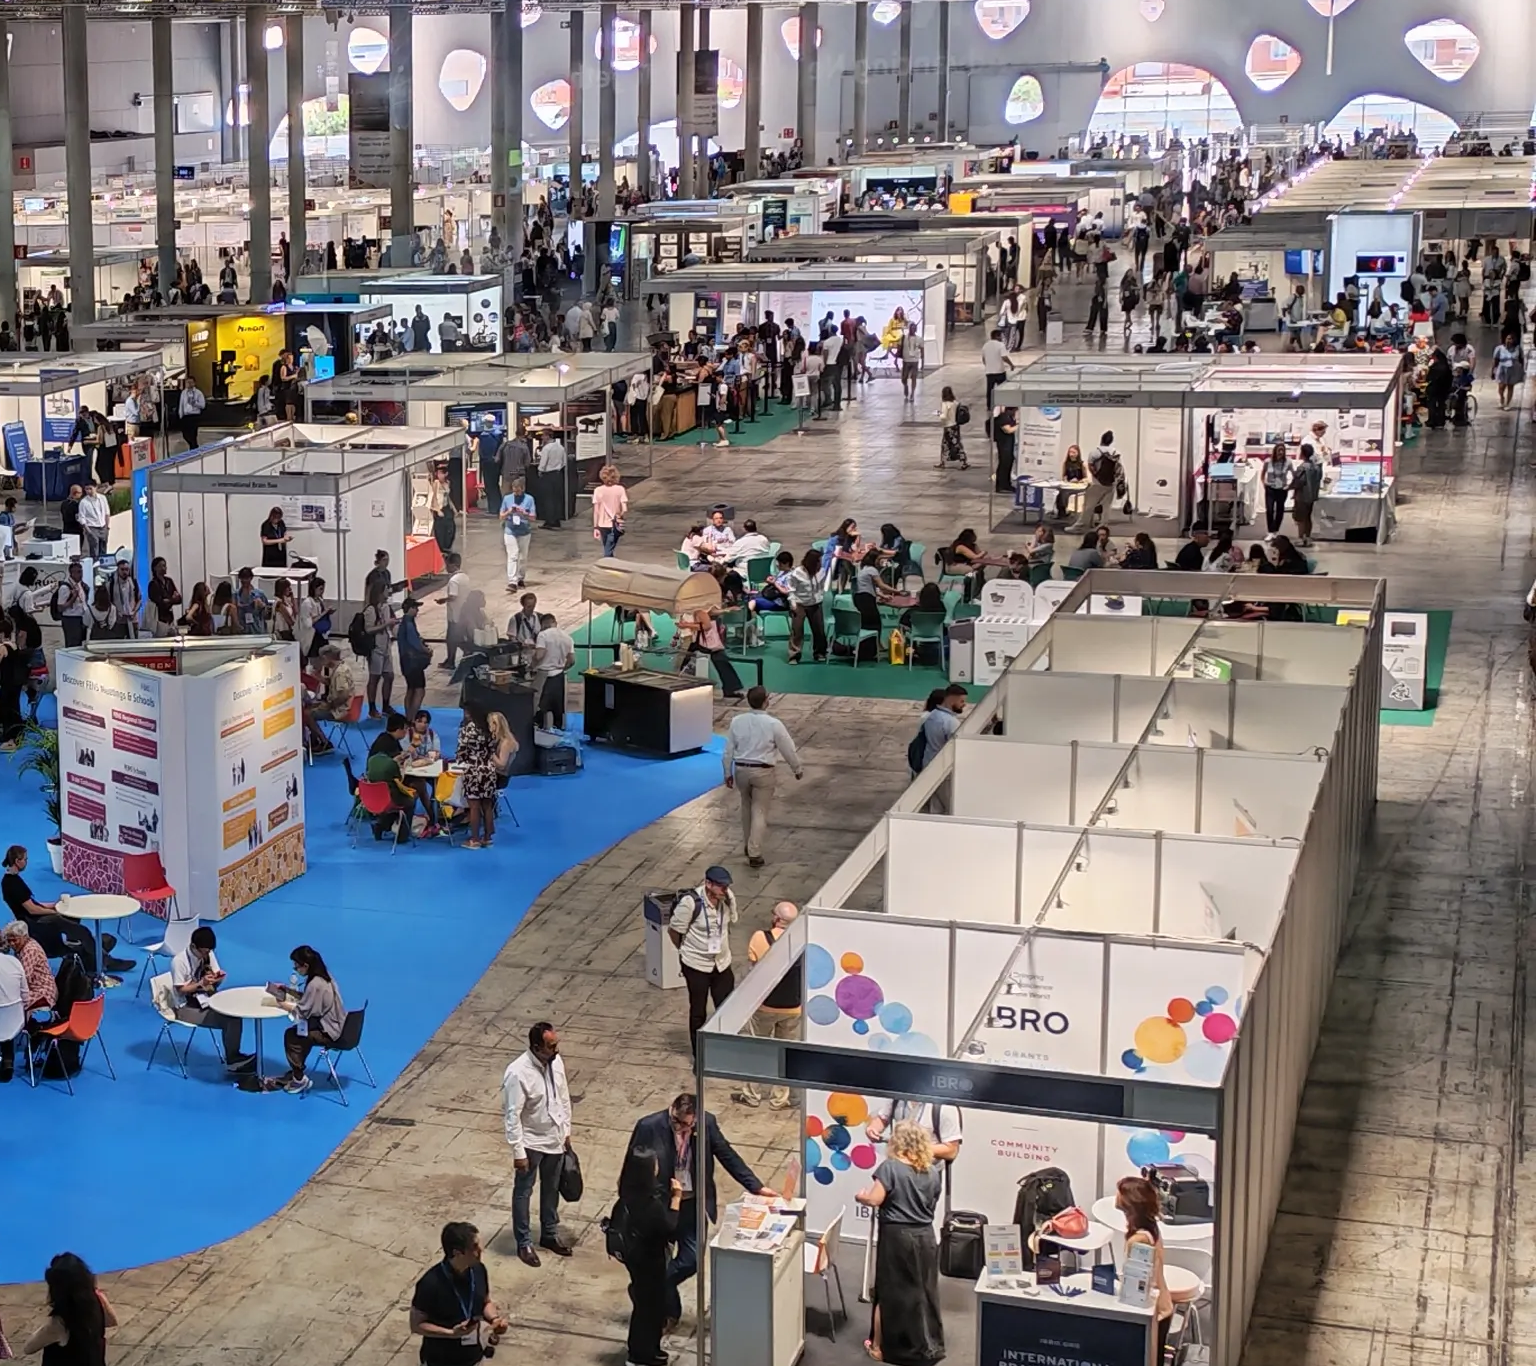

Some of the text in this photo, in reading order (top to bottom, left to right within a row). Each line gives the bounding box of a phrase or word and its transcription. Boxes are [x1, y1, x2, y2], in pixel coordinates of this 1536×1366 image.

[62, 673, 85, 688] Discover
[133, 693, 155, 708] Schools
[994, 1005, 1070, 1035] BRO
[1004, 1050, 1049, 1061] GRANTS
[931, 1075, 974, 1092] IBRO
[991, 1139, 1059, 1153] COMMUNITY
[997, 1149, 1051, 1162] BUILDING
